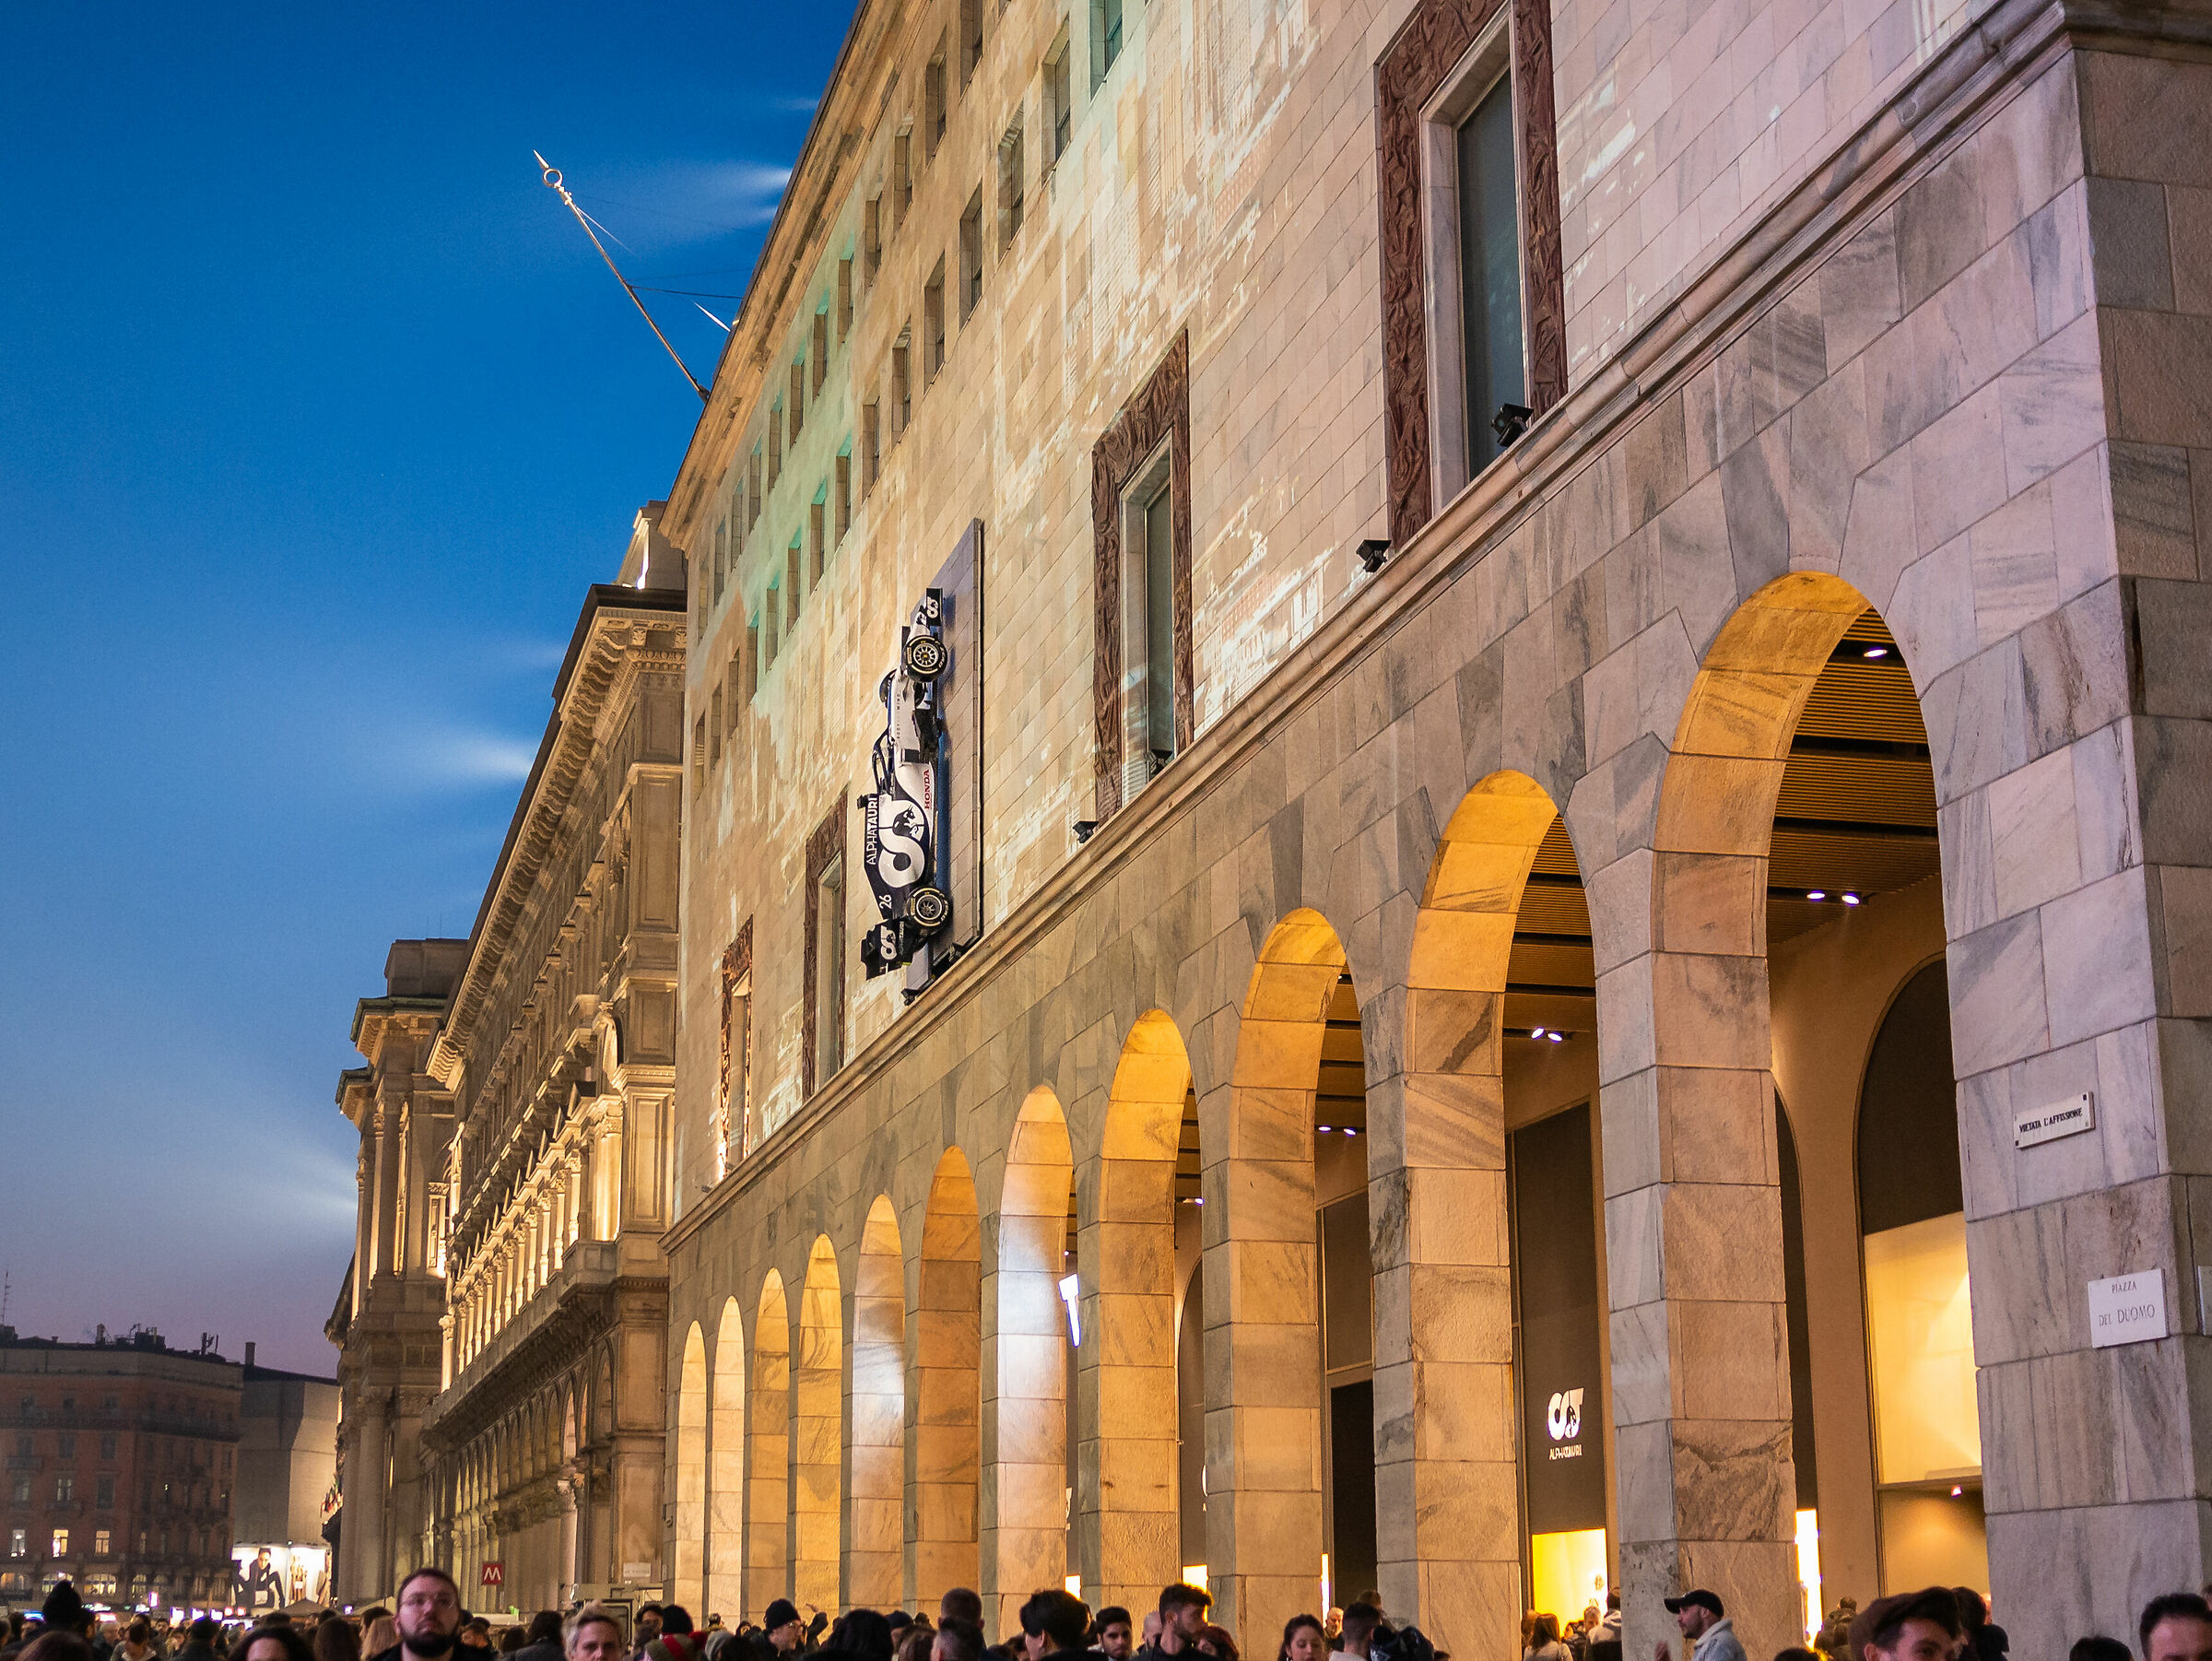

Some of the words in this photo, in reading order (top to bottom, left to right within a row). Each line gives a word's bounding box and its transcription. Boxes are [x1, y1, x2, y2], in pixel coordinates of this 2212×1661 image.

[865, 797, 878, 866] ALPHATAURI
[878, 894, 892, 910] 26
[2018, 1120, 2042, 1134] VIETATA
[2043, 1107, 2083, 1126] L'AFFISSIONE
[2112, 1280, 2137, 1293] PIAZZA
[2099, 1313, 2112, 1326] DEL
[2117, 1303, 2156, 1324] DUOMO
[483, 1566, 501, 1582] M
